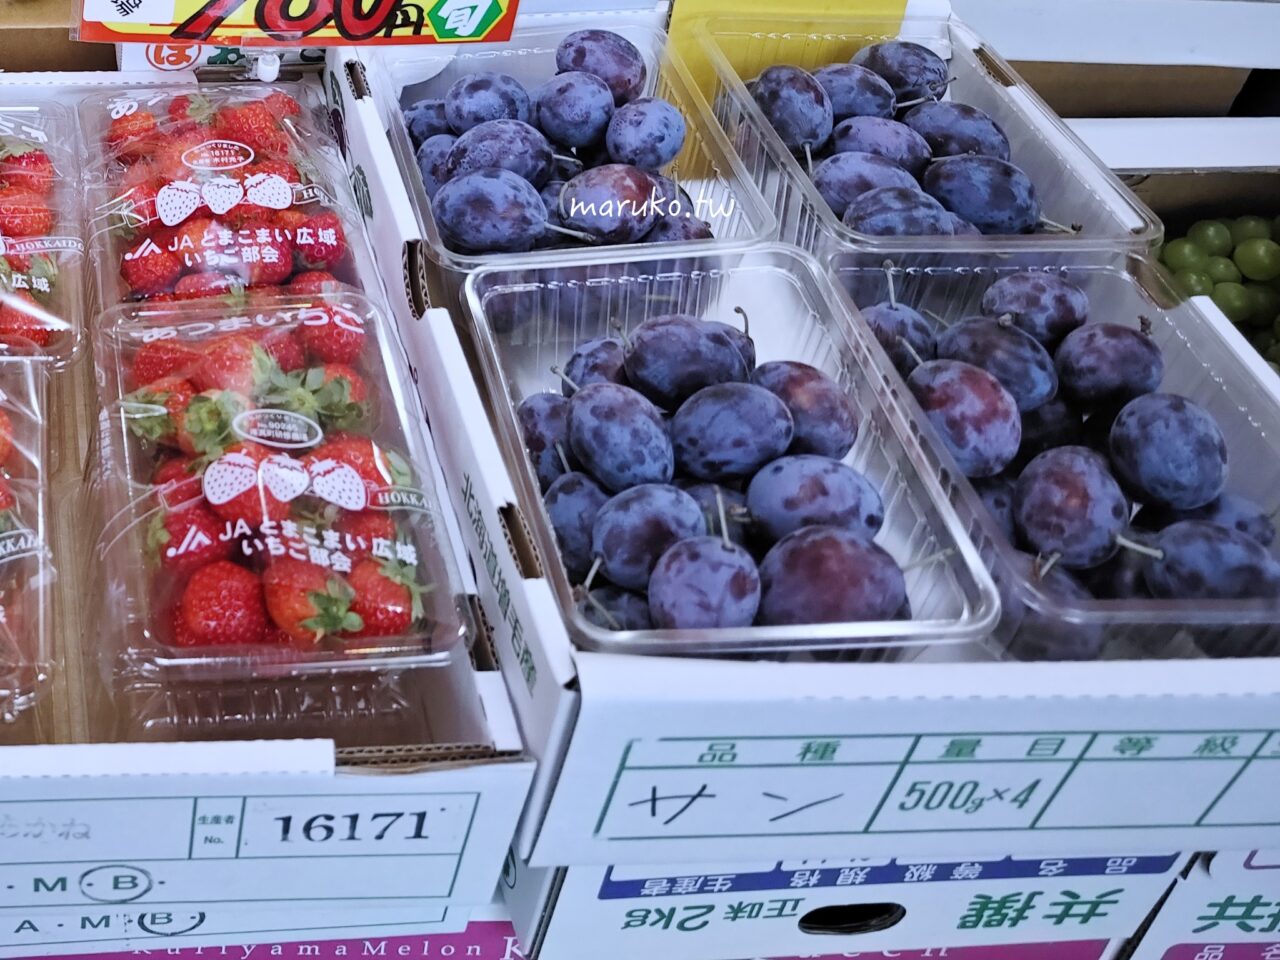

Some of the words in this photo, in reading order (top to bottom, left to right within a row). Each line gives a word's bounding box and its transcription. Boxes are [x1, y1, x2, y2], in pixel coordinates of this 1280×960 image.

[185, 245, 280, 268] いちご部会
[241, 536, 353, 574] いちご部会
[696, 739, 842, 763] 品種
[938, 737, 1065, 760] 量目
[1112, 734, 1240, 757] 等級
[197, 812, 236, 827] 生産者
[274, 809, 433, 844] 16171
[203, 834, 225, 847] No.
[641, 874, 737, 897] 生産者
[789, 867, 871, 888] 規格
[723, 897, 806, 922] 正味
[1192, 894, 1280, 934] 共
